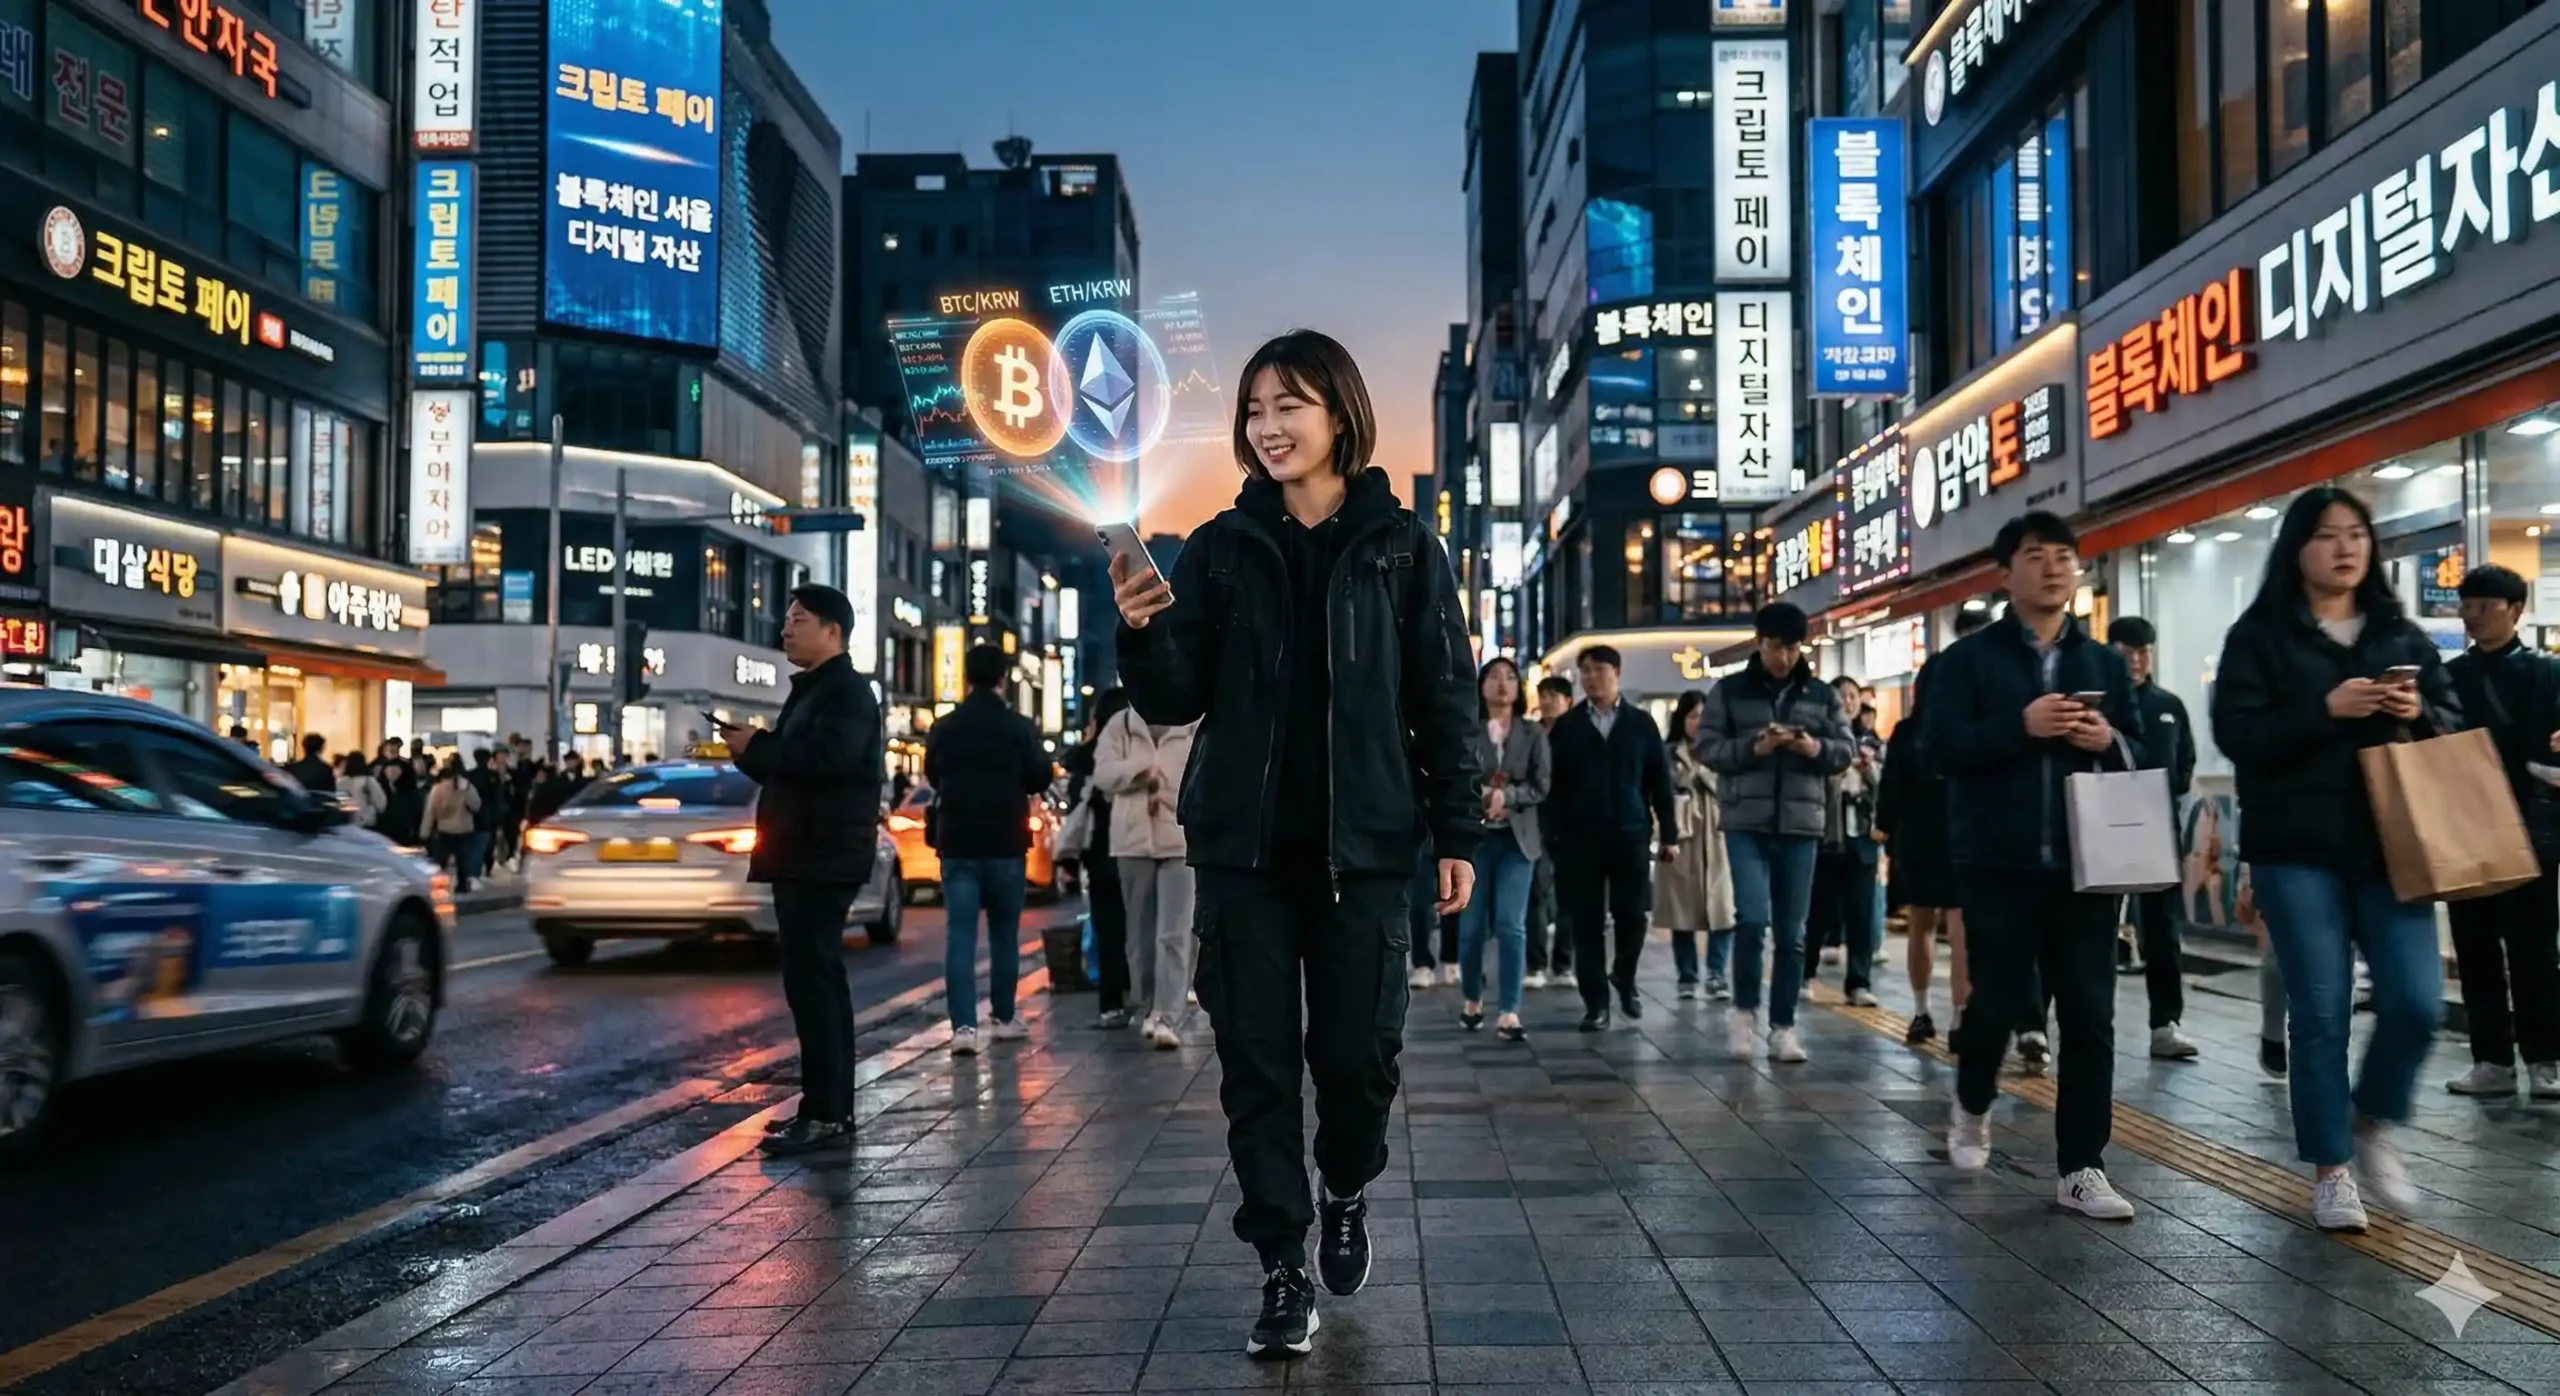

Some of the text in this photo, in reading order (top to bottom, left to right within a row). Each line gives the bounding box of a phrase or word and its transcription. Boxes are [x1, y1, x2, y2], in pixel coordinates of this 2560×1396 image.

[556, 63, 650, 115] 크립토
[556, 173, 713, 233] 블록체인 서울
[568, 220, 702, 272] 디지털 자산
[92, 231, 187, 315] 크립토
[195, 277, 250, 345] 페이
[939, 290, 1020, 314] BTC/KRW
[1050, 279, 1132, 303] ETH/KRW
[1595, 302, 1713, 345] 블록체인
[2086, 267, 2244, 440] 블록체인
[1739, 302, 1771, 479] 디지털자산
